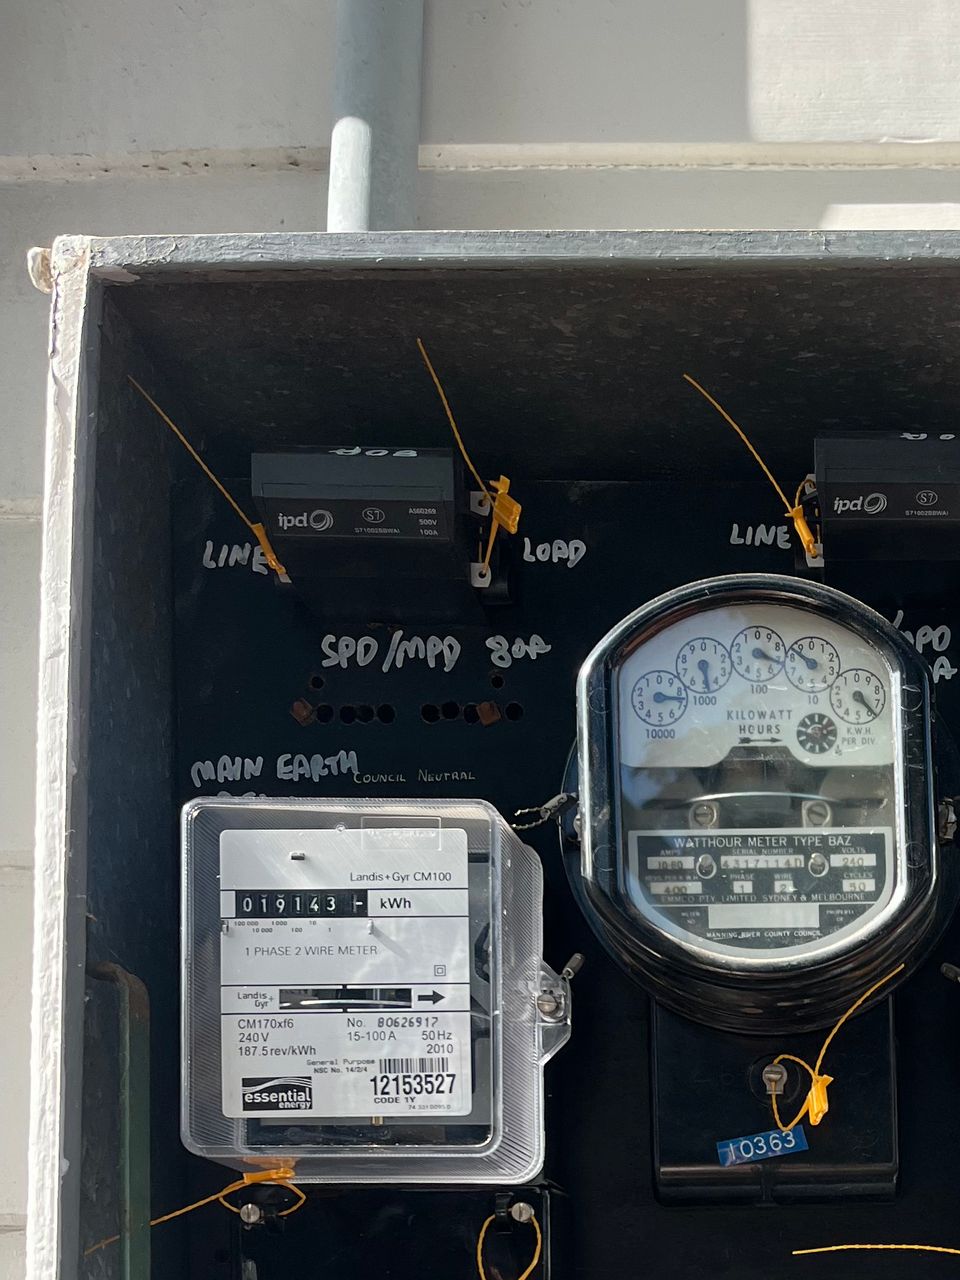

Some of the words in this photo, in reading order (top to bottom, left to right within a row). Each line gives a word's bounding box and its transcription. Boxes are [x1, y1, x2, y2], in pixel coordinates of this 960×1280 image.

[834, 496, 863, 514] ipd
[278, 513, 307, 530] ipd
[729, 524, 791, 549] LINE
[203, 540, 268, 575] LINE
[523, 537, 586, 568] LOAD
[751, 685, 767, 694] 100
[693, 696, 717, 705] 1000
[808, 695, 818, 704] 10
[727, 710, 793, 721] KILOWATT
[645, 729, 675, 739] 10000
[740, 725, 781, 734] HOURS
[190, 755, 263, 788] MAIN
[276, 750, 360, 782] EARTH
[353, 772, 406, 783] COUNCIL
[418, 769, 476, 782] NEUTRAL
[674, 837, 742, 847] WATTHOUR
[748, 837, 787, 847] METER
[793, 836, 822, 846] TYPE
[829, 836, 851, 846] BAZ
[413, 872, 451, 882] CM100
[380, 898, 411, 909] kWh
[255, 947, 291, 955] PHASE
[295, 947, 300, 955] 2
[305, 947, 334, 955] WIRE
[338, 946, 377, 955] METER
[238, 1019, 294, 1029] CM170xf6
[378, 1017, 438, 1027] 80626917
[427, 1044, 453, 1054] 2010
[370, 1074, 456, 1095] 12153527
[245, 1089, 311, 1102] essential
[279, 1100, 311, 1109] energy
[729, 1130, 796, 1159] 10363
